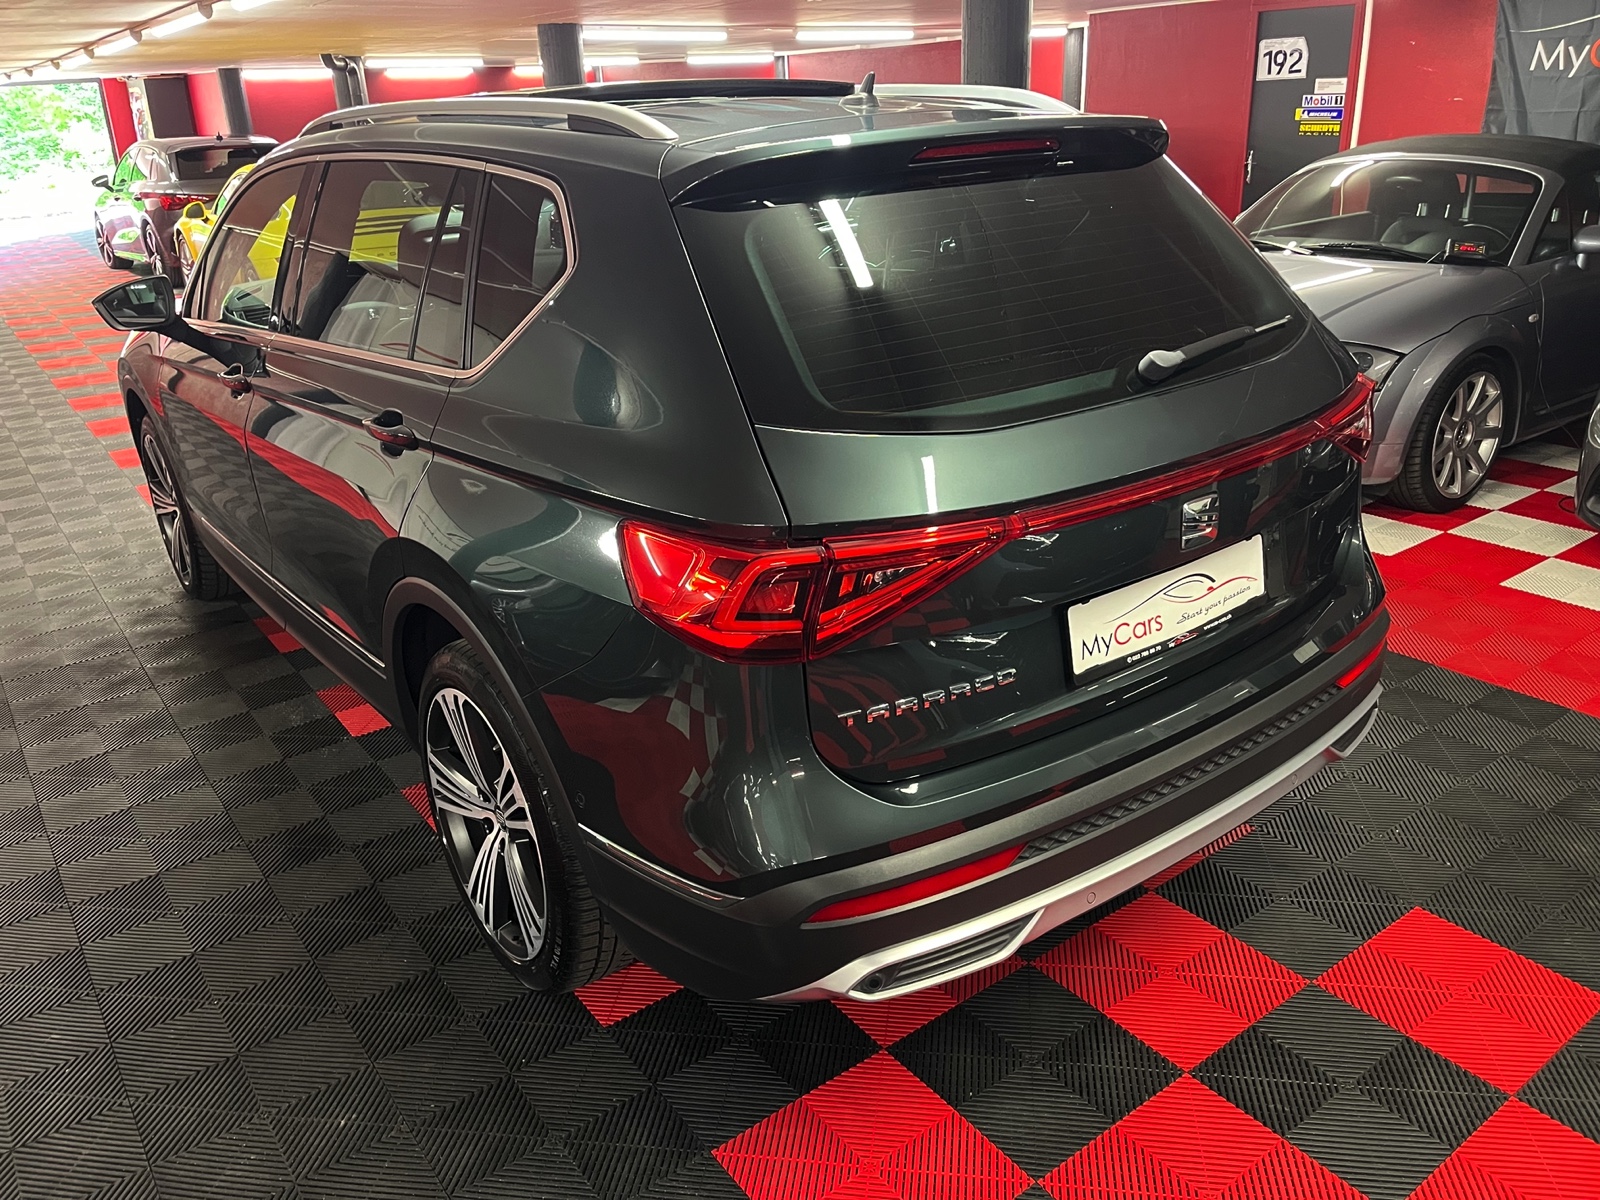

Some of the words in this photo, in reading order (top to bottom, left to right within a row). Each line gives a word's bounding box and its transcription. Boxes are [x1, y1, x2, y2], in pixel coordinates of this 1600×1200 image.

[1263, 48, 1303, 75] 192
[1304, 96, 1333, 105] Mobil
[1299, 124, 1341, 132] SCHROTH
[1176, 607, 1203, 624] Start
[1204, 599, 1222, 616] your
[1222, 585, 1251, 607] passion
[1082, 615, 1163, 660] MyCars
[837, 668, 1016, 727] TARRACO
